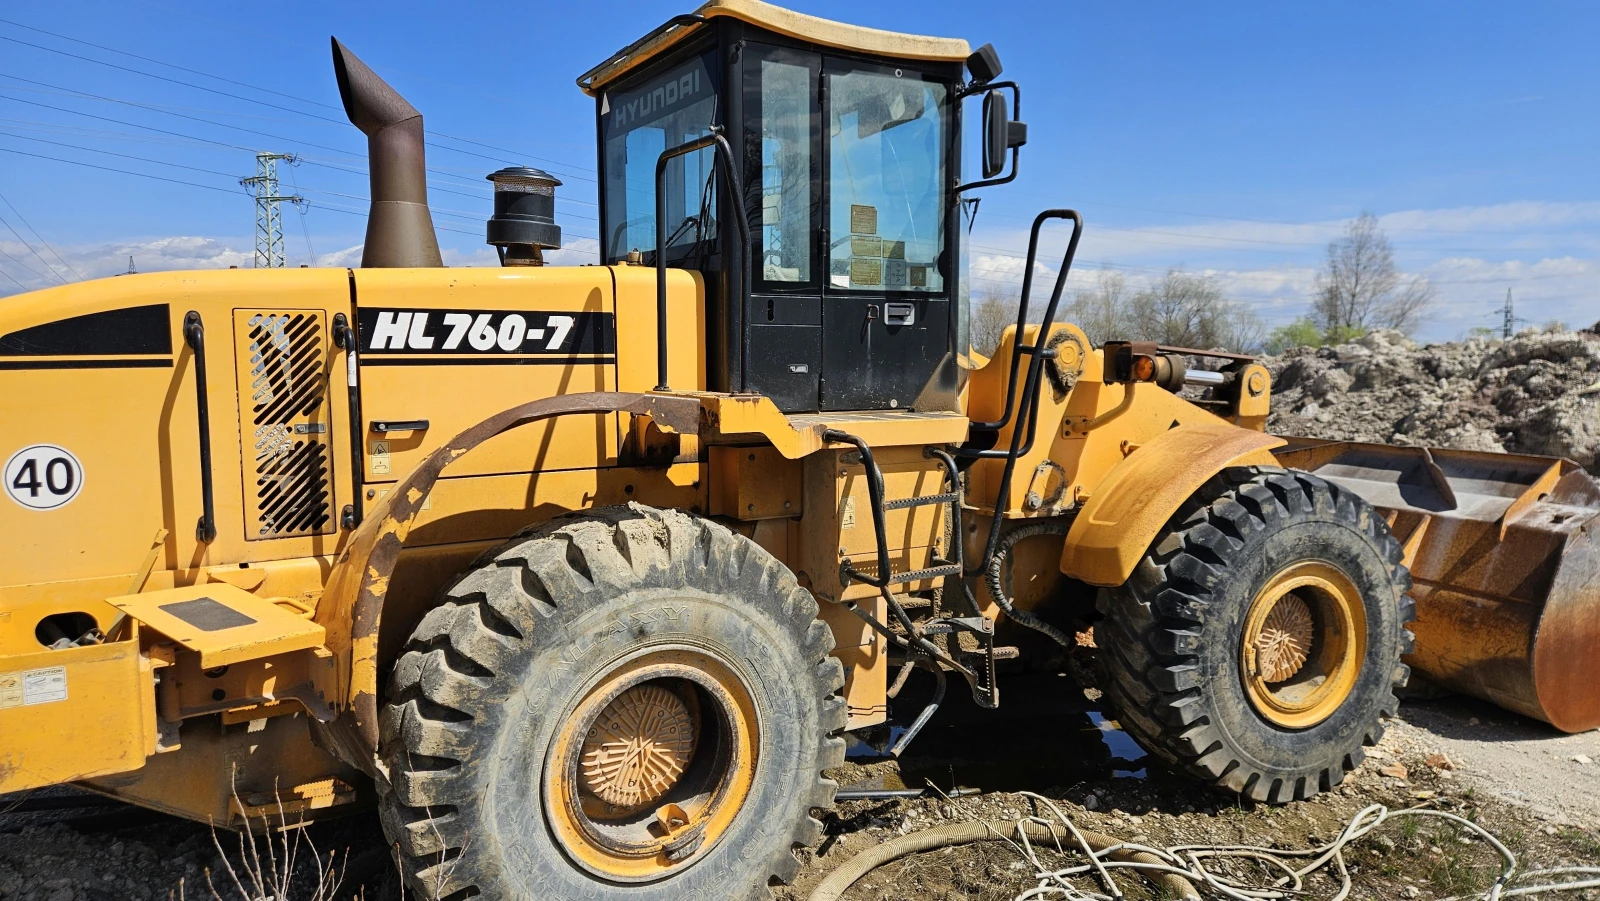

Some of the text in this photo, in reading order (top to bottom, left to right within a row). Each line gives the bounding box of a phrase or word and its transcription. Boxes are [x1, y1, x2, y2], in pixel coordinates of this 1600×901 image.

[615, 68, 700, 128] HYUNDAI
[370, 312, 575, 351] HL 760-7
[13, 457, 74, 497] 40
[526, 605, 688, 714] GALAXY
